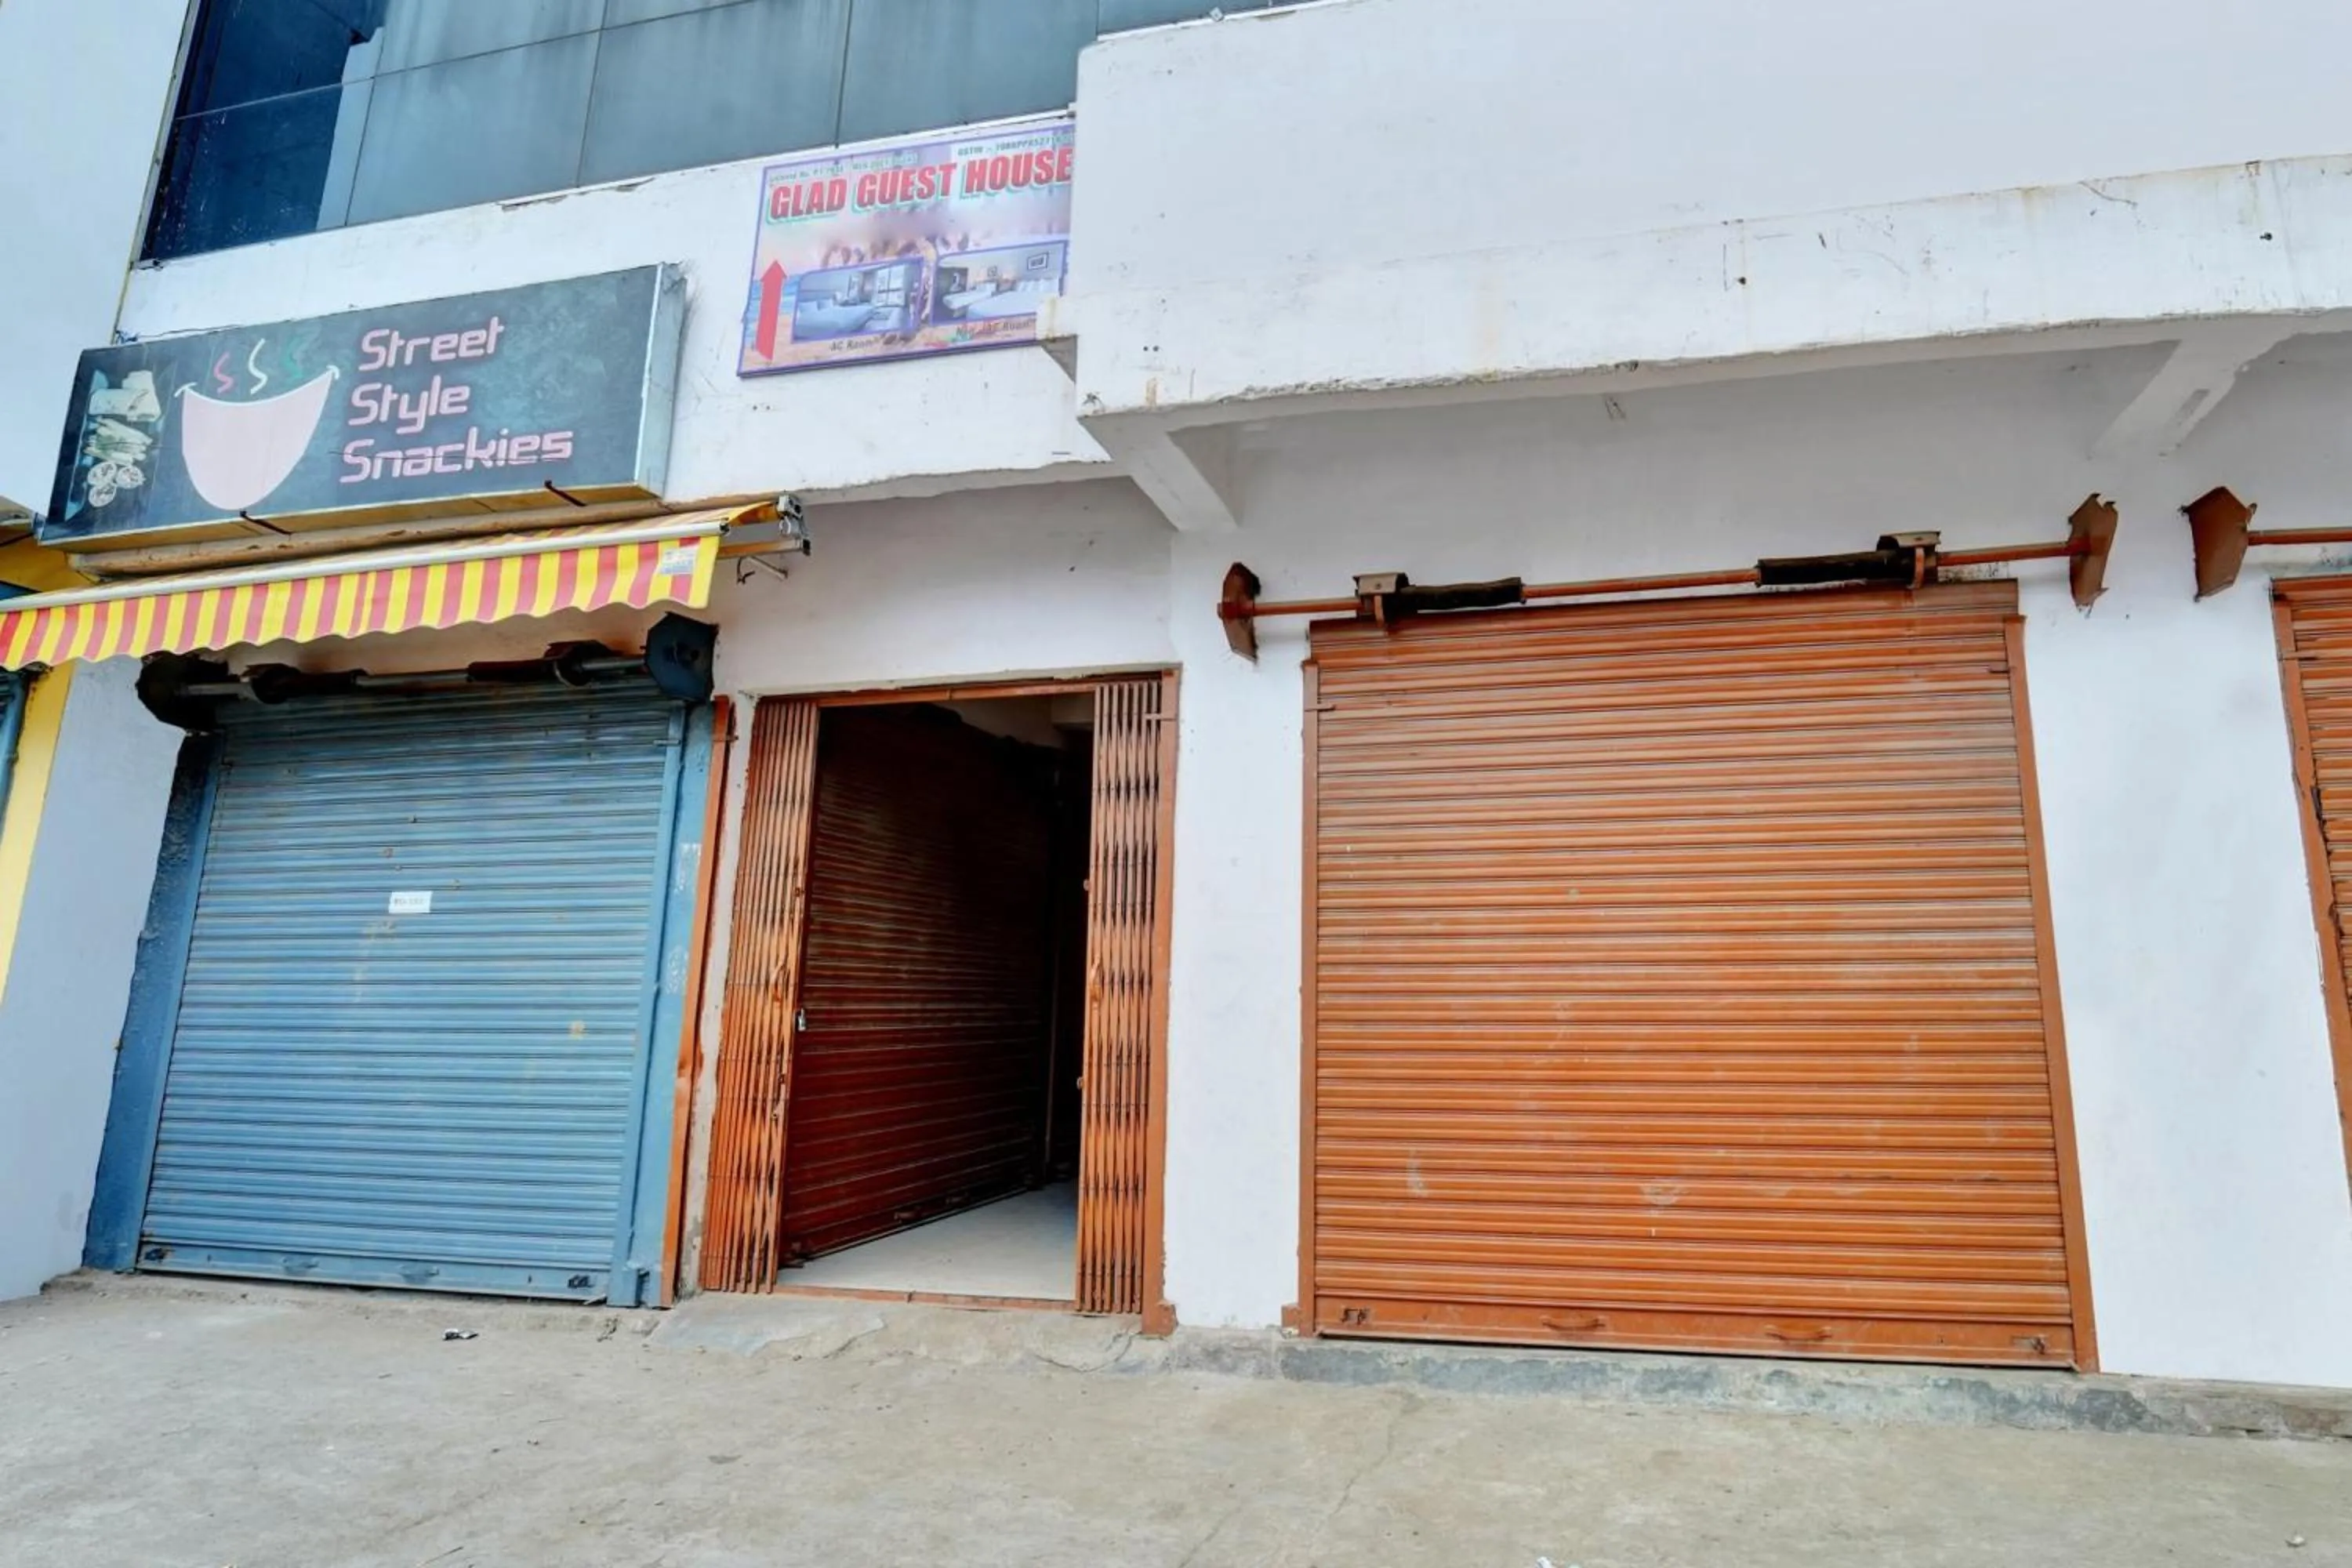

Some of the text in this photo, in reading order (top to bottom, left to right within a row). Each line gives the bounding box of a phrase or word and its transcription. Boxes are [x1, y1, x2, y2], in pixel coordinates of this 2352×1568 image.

[770, 178, 848, 220] GLAD
[856, 163, 956, 209] GUEST
[964, 146, 1073, 194] HOUSE
[358, 316, 505, 371] Street
[348, 375, 470, 434] Style
[339, 426, 574, 484] Snackies
